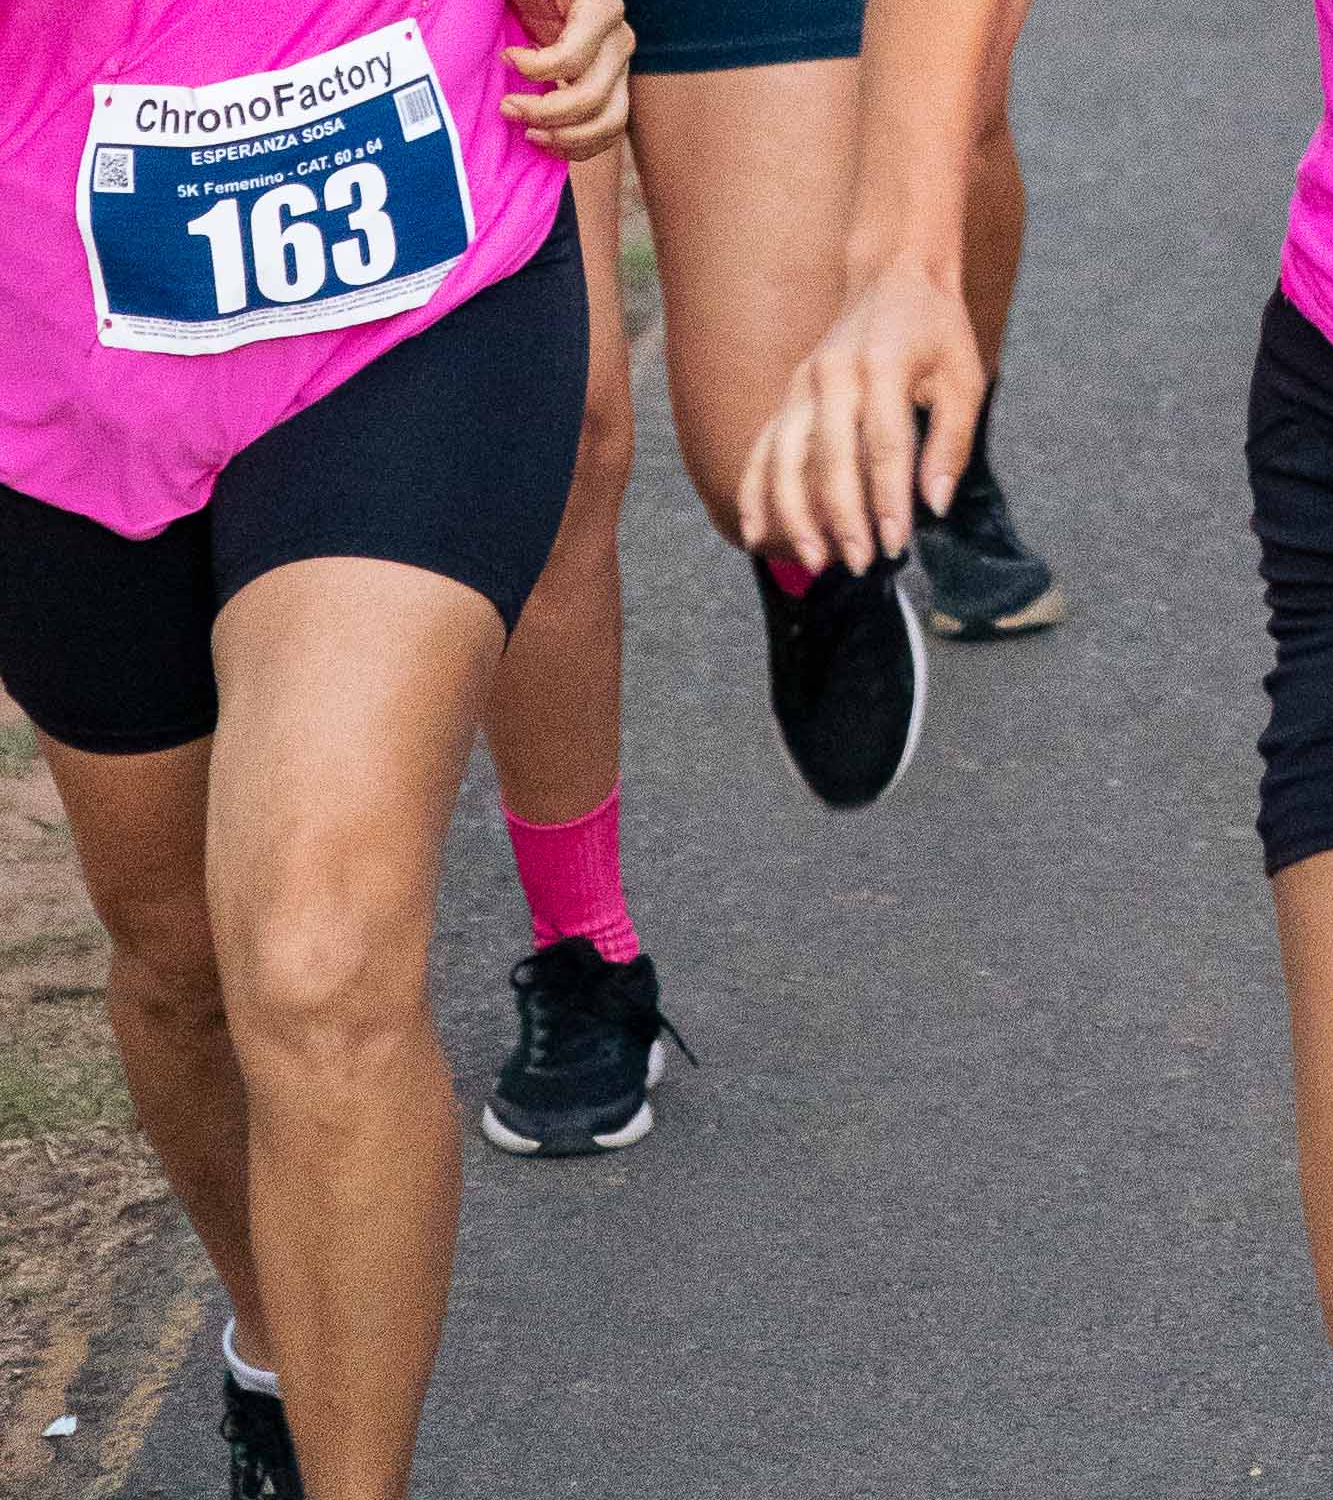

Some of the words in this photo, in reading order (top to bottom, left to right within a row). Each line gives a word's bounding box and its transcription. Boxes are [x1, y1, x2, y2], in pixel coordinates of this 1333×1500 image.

[135, 51, 394, 134] ChronoFactory
[177, 183, 199, 199] 5K
[204, 172, 284, 196] Femenino
[296, 156, 332, 177] CAT.
[334, 148, 353, 166] 60
[354, 147, 365, 160] a
[366, 137, 384, 155] 64
[191, 133, 299, 166] ESPERANZA
[301, 117, 346, 144] SOSA
[186, 162, 397, 315] 163
